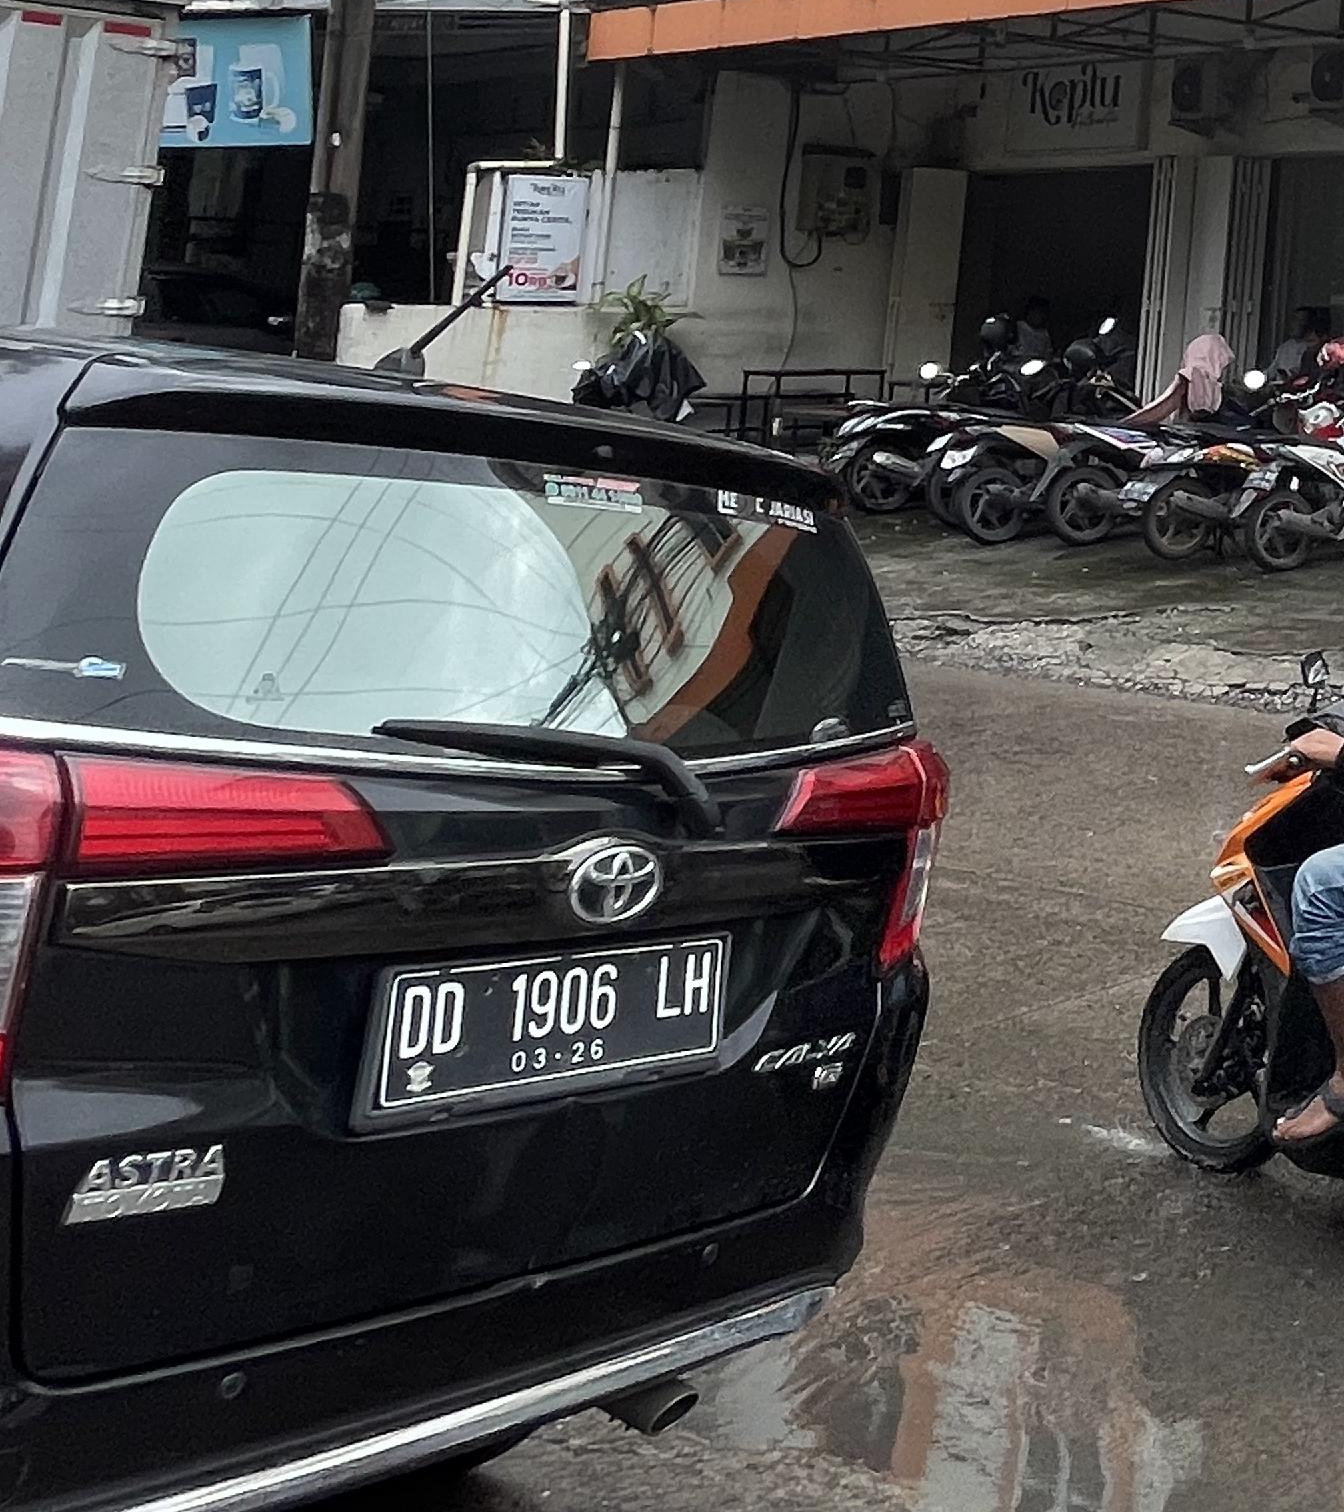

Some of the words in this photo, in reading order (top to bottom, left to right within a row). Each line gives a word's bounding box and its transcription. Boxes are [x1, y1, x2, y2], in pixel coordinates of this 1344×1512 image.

[398, 981, 465, 1060] DD
[511, 963, 618, 1042] 1906
[655, 951, 713, 1019] LH
[79, 1144, 224, 1194] ASTRA
